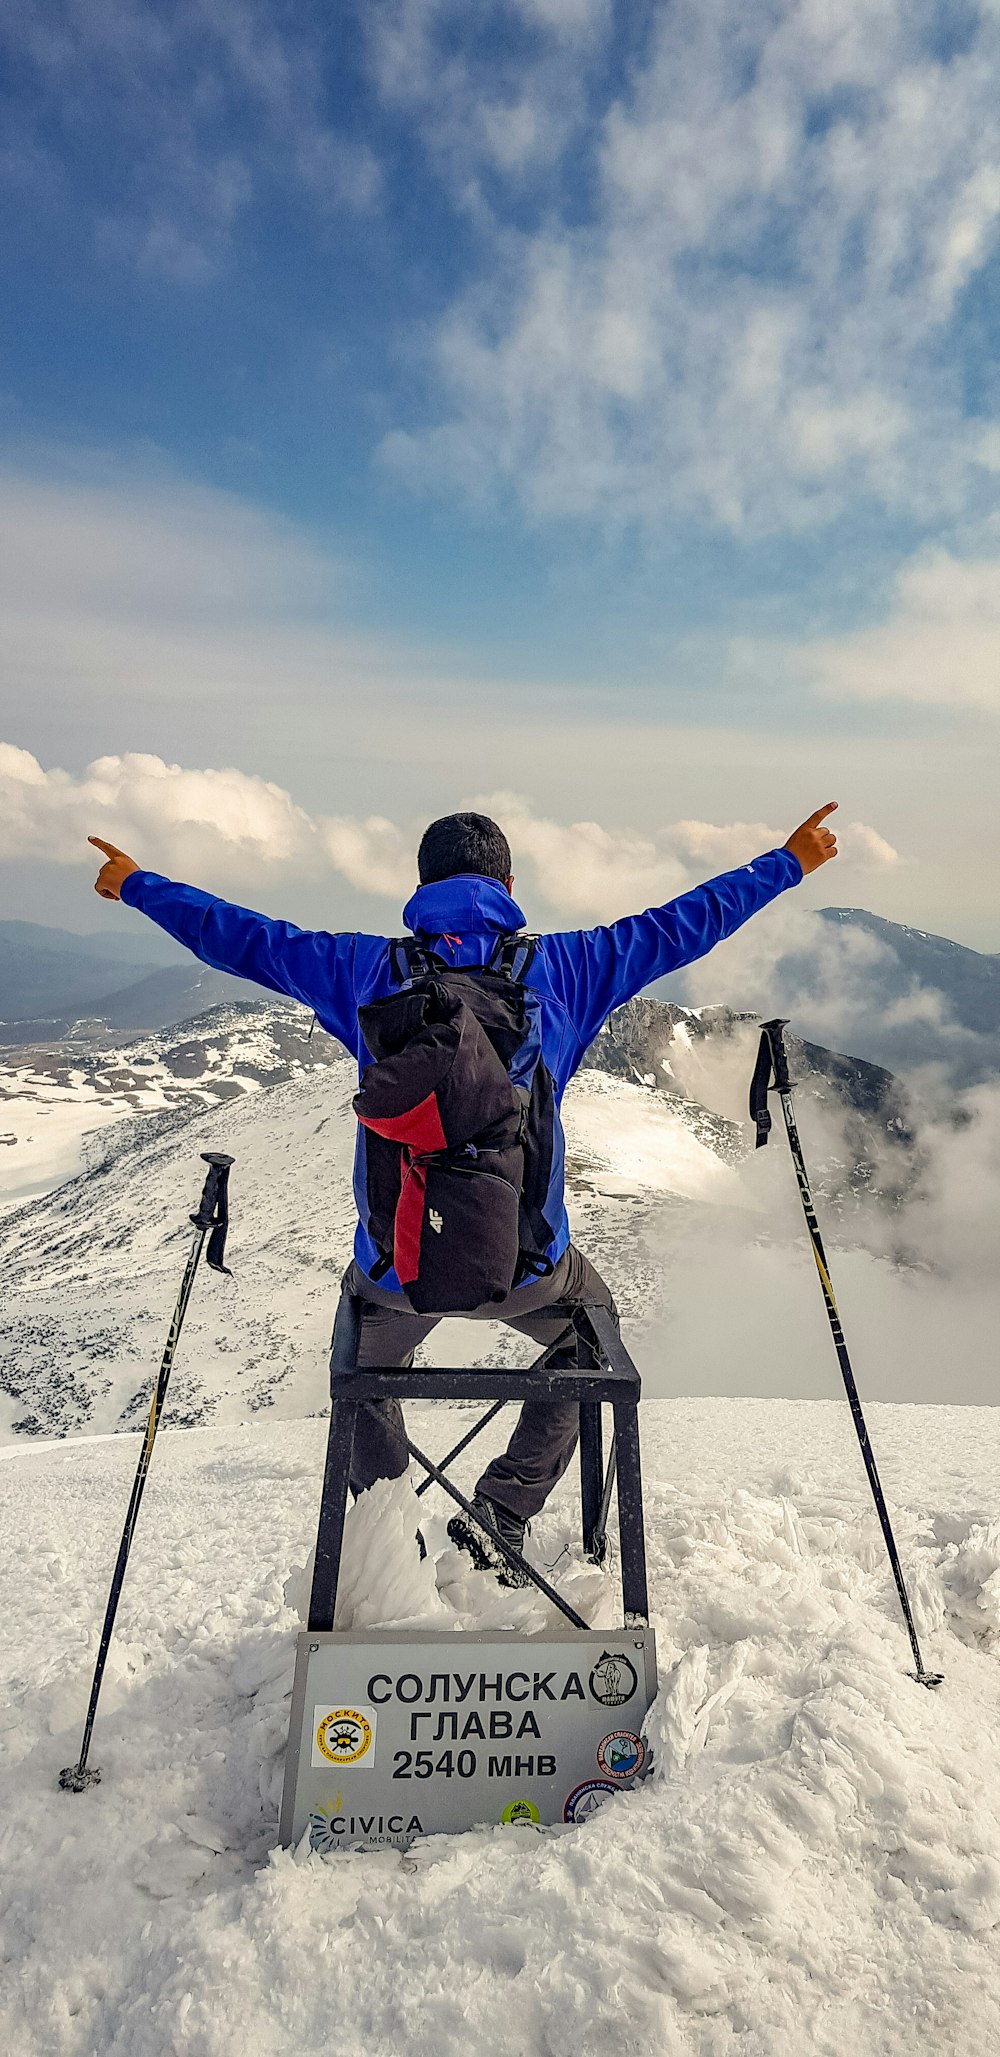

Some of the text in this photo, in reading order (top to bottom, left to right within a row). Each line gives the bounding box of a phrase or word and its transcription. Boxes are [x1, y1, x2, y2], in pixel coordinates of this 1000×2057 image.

[428, 1207, 443, 1234] 4F
[367, 1672, 585, 1703] СОЛУНСКА
[319, 1709, 371, 1731] МОСКИТО
[410, 1711, 542, 1741] ГЛАВА
[393, 1750, 477, 1779] 2540
[569, 1782, 619, 1807] ПЛАНИНСКА СЛУЖБ
[330, 1815, 424, 1836] CIVICA
